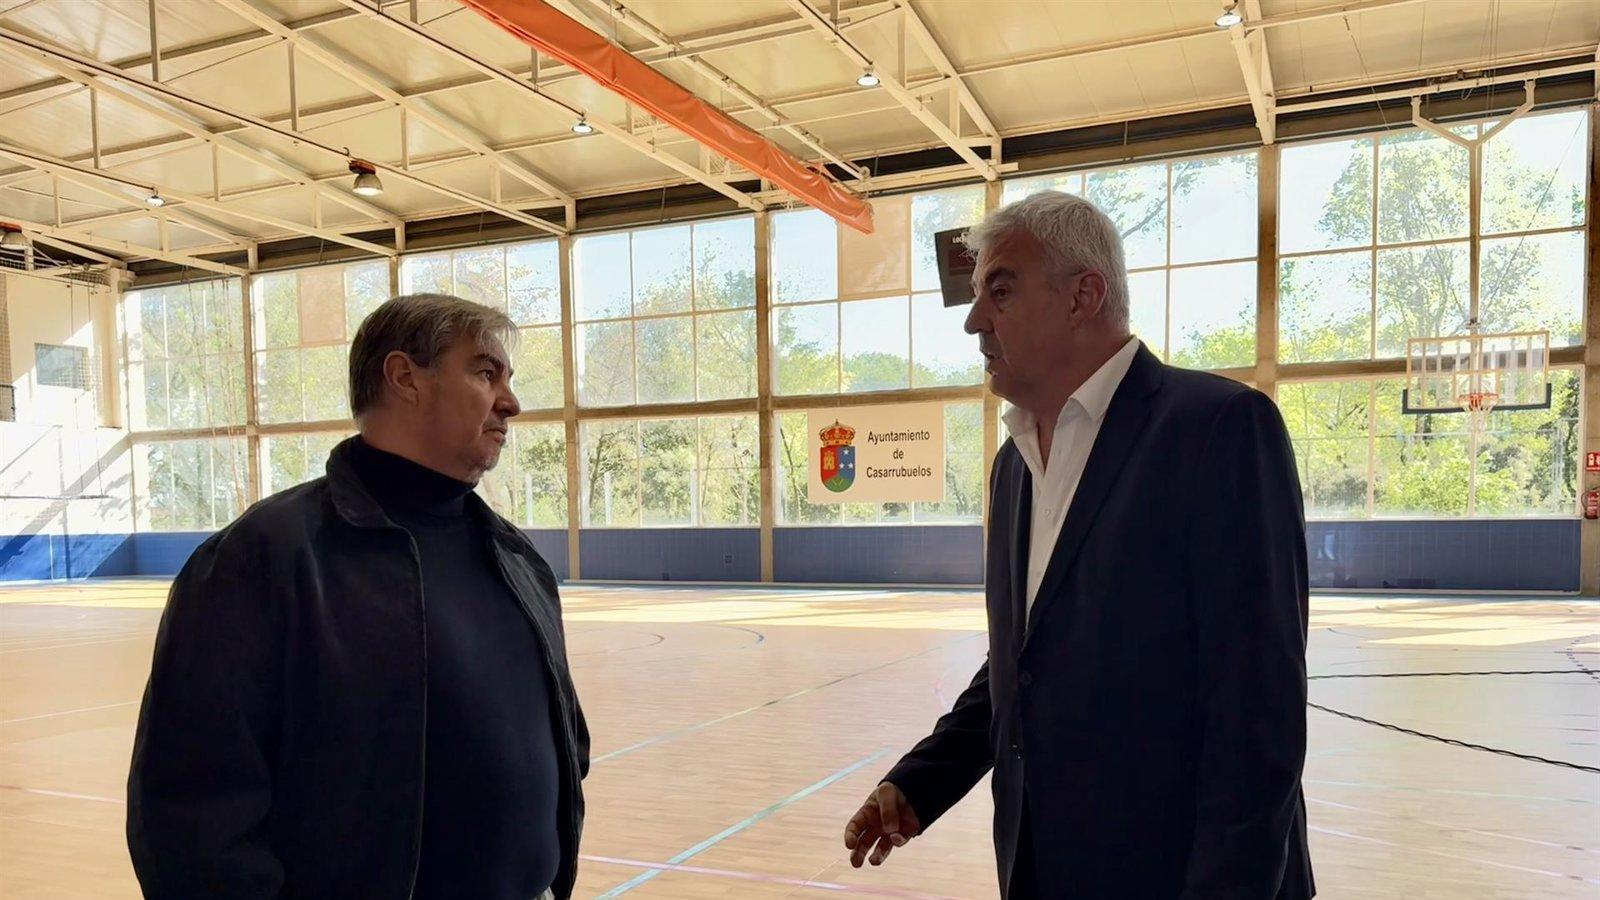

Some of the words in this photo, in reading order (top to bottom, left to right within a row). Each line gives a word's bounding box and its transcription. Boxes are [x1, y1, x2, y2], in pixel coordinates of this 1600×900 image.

[867, 429, 931, 445] Ayuntamiento
[893, 448, 904, 460] de
[866, 466, 932, 479] Casarrubuelos
